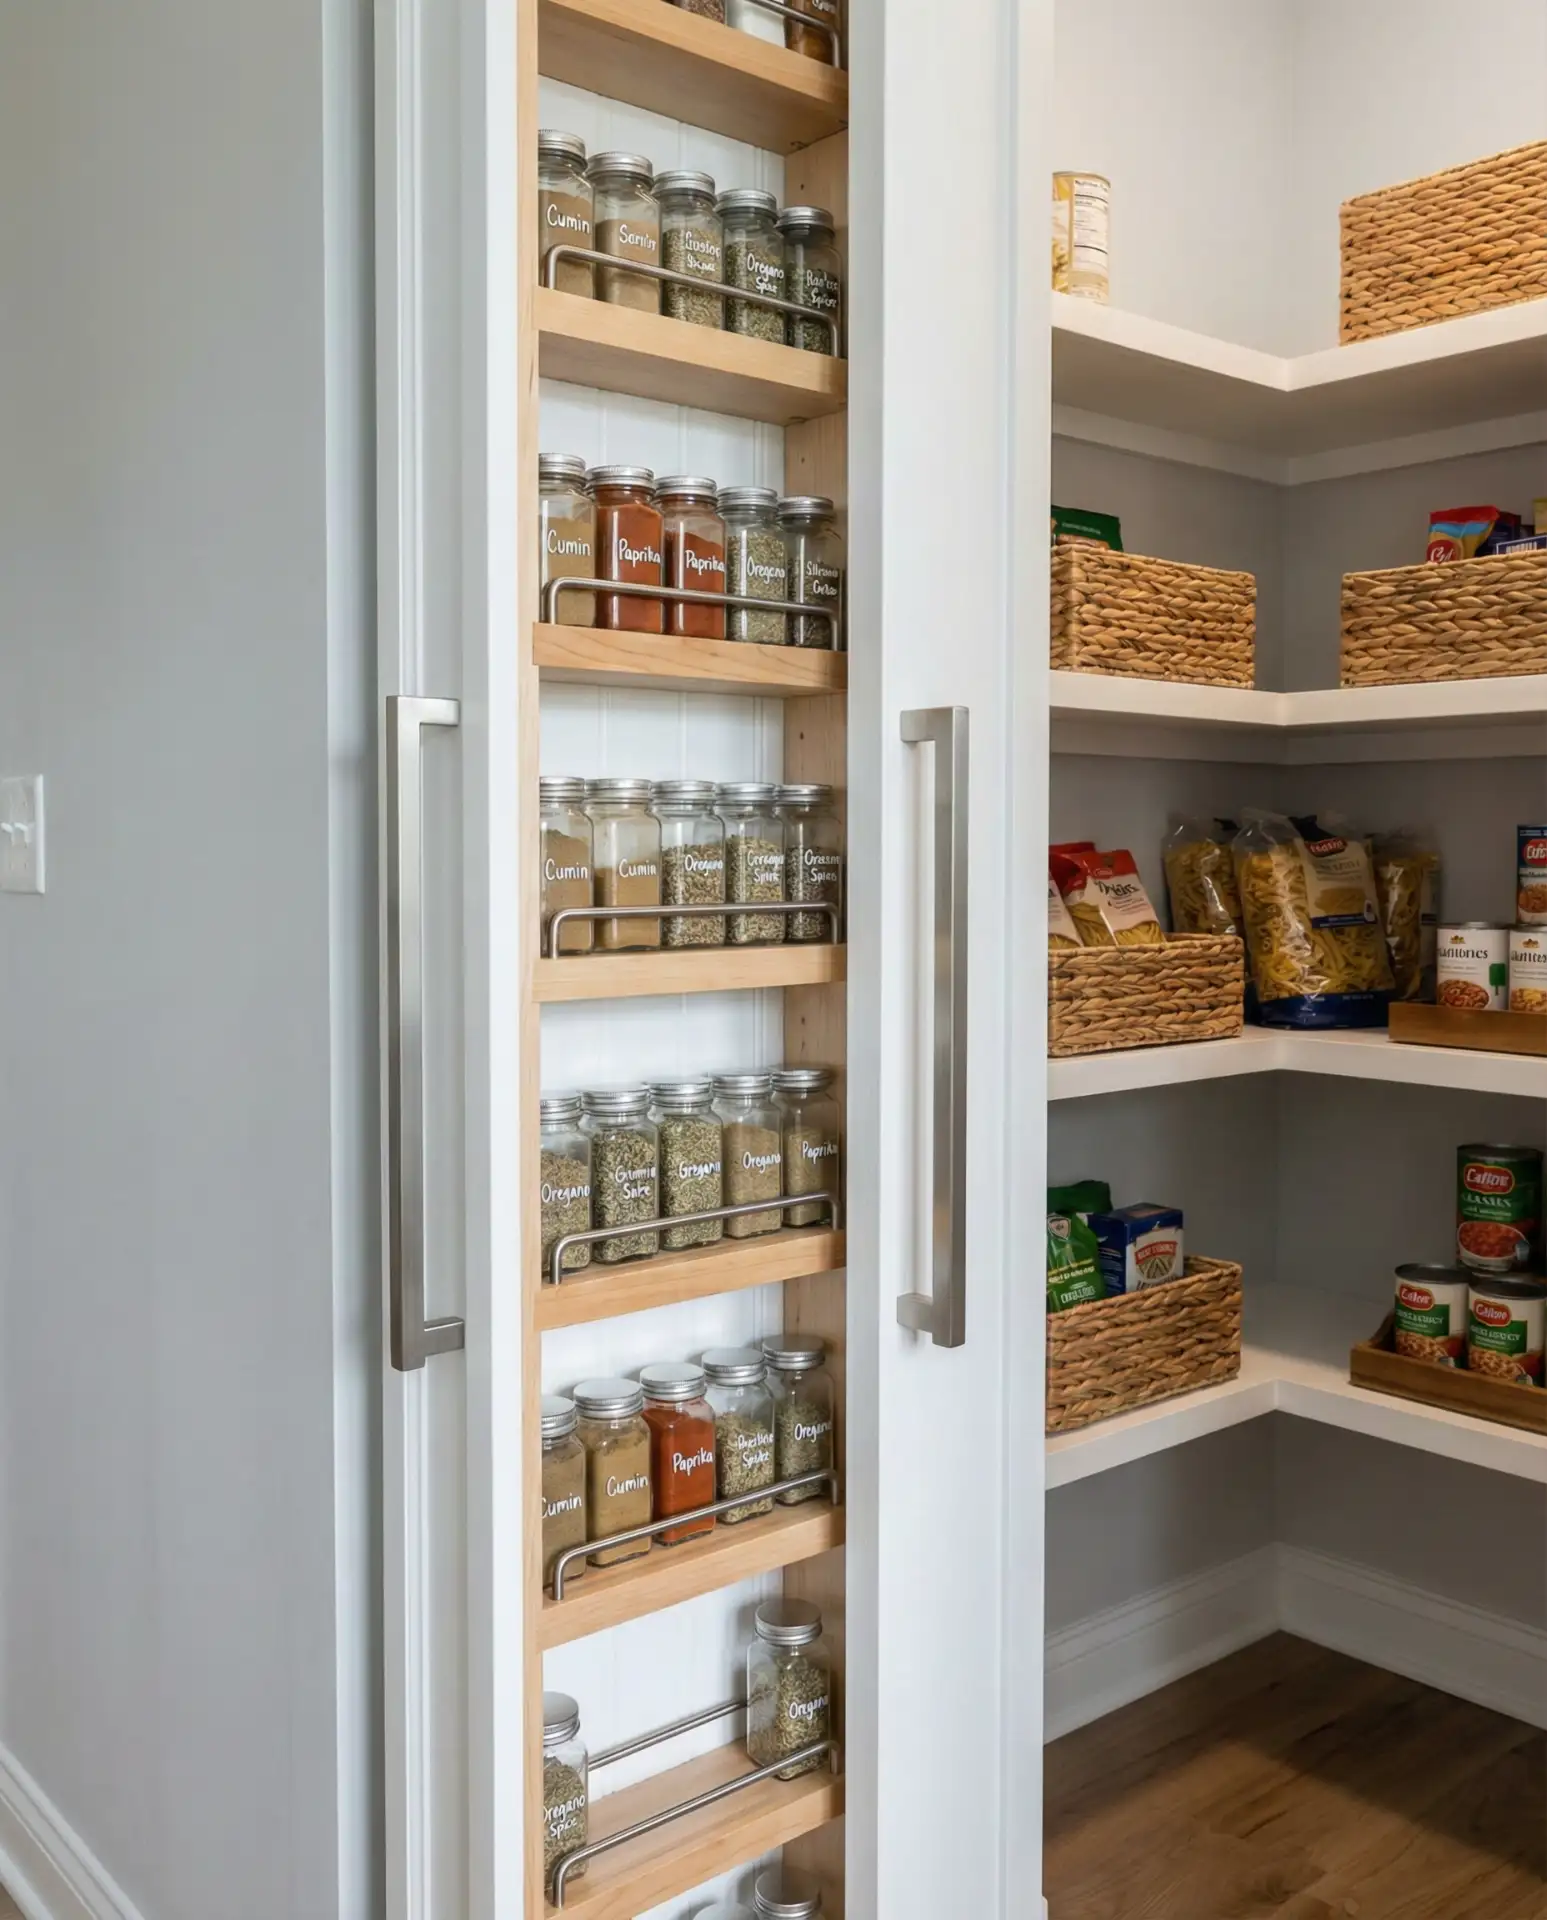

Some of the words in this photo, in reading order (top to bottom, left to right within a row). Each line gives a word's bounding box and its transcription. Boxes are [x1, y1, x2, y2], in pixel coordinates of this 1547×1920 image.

[546, 203, 590, 235] Cumin
[547, 529, 591, 557] Cumin
[618, 538, 661, 568] Paprika
[685, 549, 725, 576] Paprika
[545, 858, 588, 881] Cumin
[619, 857, 657, 878] Cumin
[541, 1182, 590, 1208] Oregano
[673, 1446, 714, 1476] Paprika
[607, 1473, 648, 1497] Cumin
